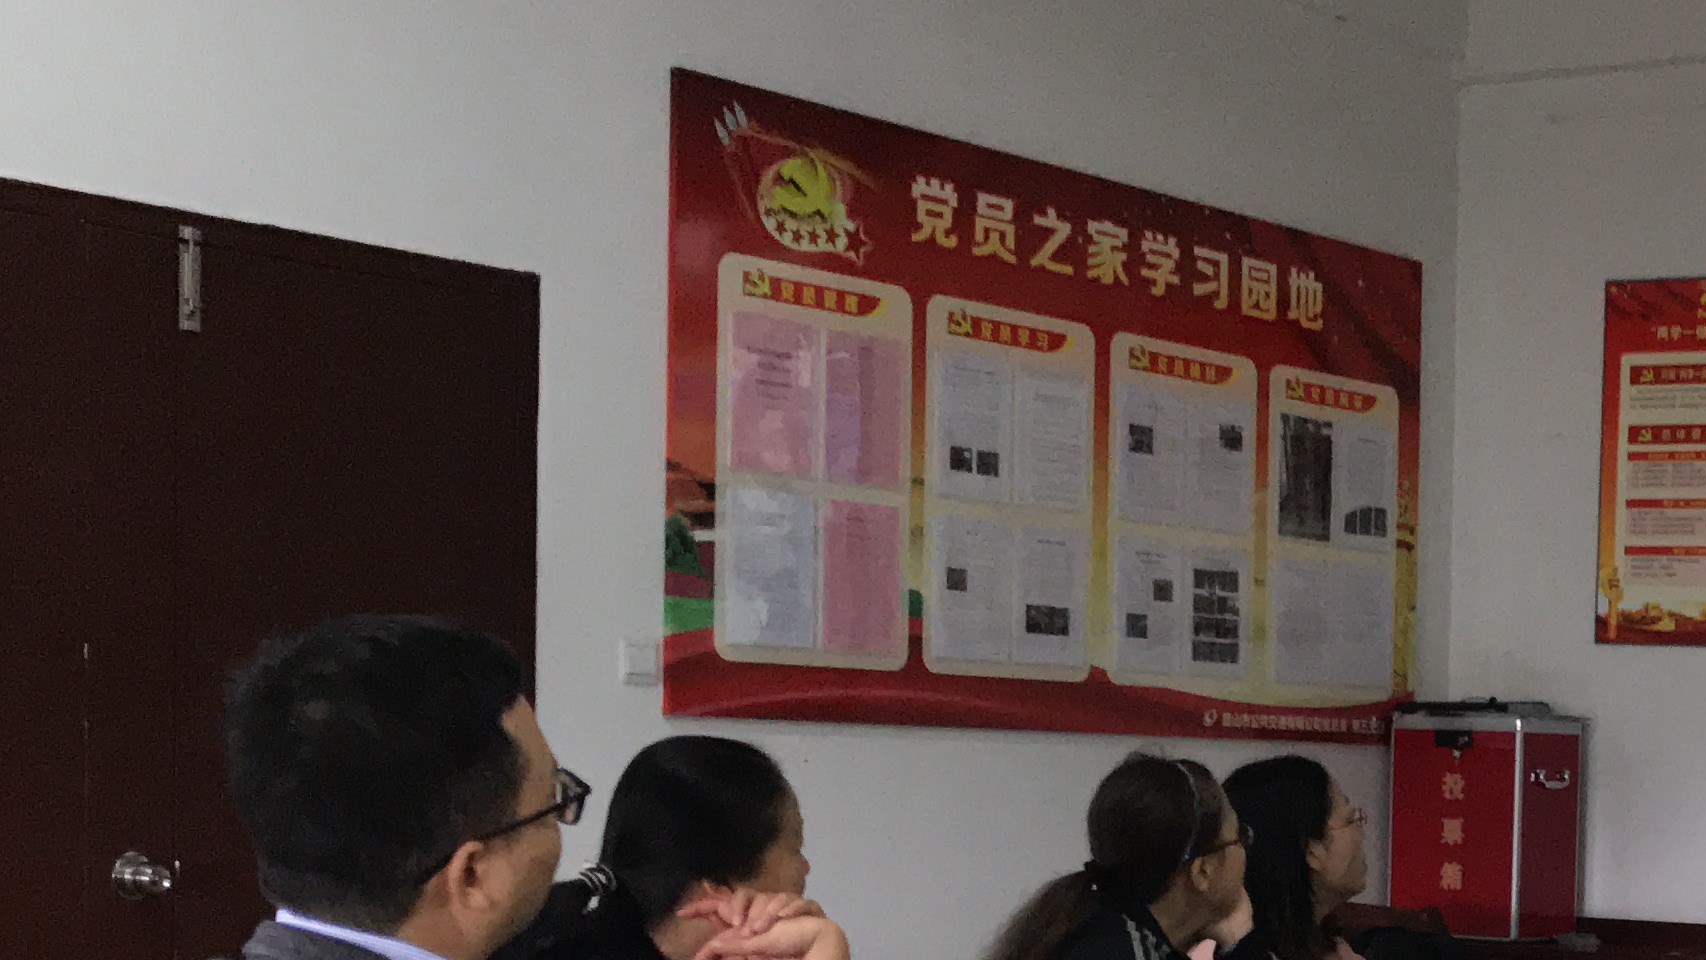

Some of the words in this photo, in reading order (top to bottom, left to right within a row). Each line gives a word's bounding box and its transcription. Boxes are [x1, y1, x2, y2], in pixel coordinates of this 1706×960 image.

[910, 174, 1326, 332] 党员之家学习园地
[1440, 772, 1465, 890] 投票箱
